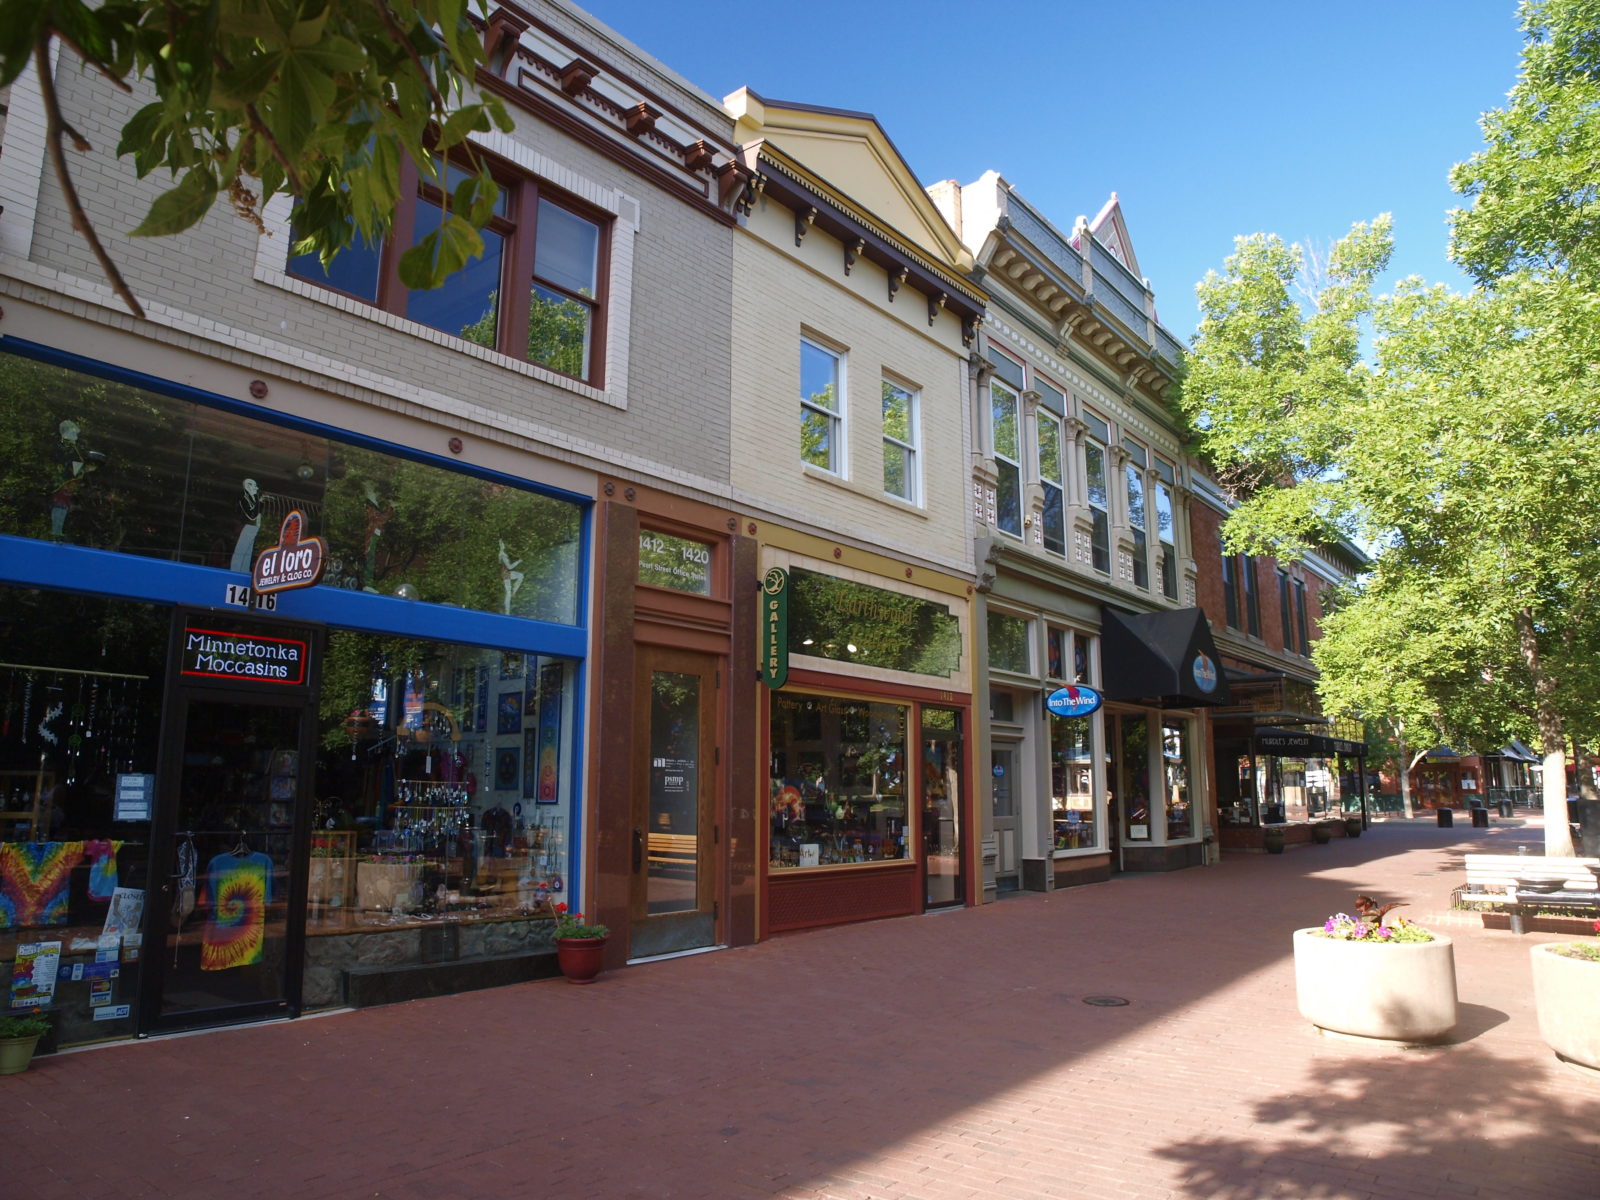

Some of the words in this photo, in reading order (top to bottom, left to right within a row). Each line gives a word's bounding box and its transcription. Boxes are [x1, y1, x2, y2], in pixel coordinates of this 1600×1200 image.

[262, 552, 278, 577] el
[280, 548, 313, 574] loro
[639, 535, 665, 554] 1412
[681, 546, 709, 564] 1420
[287, 571, 303, 581] CLOG
[186, 633, 298, 661] Minnetonka
[769, 600, 779, 679] GALLERY
[194, 653, 288, 678] Moccasins
